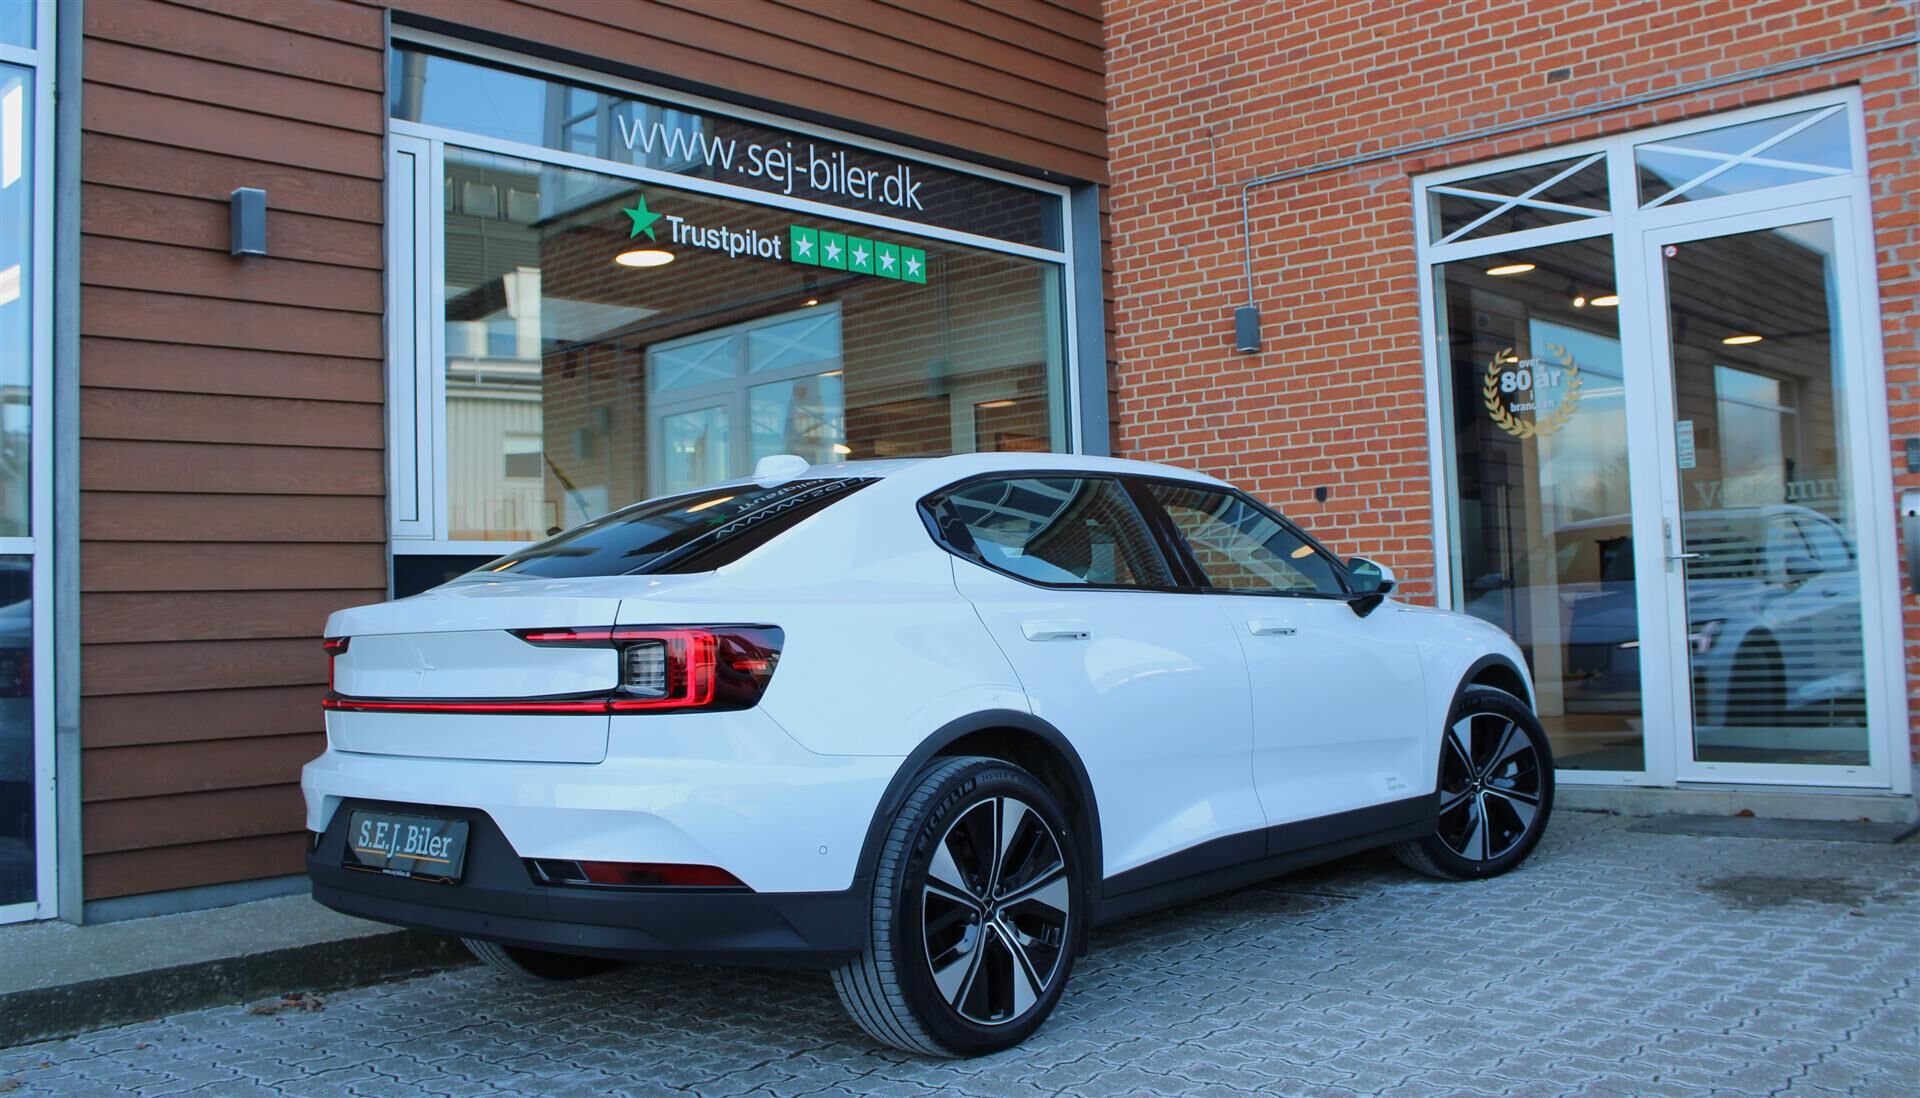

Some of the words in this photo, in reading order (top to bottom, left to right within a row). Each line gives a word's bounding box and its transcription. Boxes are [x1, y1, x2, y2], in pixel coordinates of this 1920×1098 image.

[618, 114, 923, 211] www.sej-biler.dk
[666, 215, 782, 260] Trustpilot
[1501, 369, 1532, 393] 80
[1519, 358, 1540, 369] over
[916, 779, 975, 854] MICHELIN
[358, 820, 400, 858] S.E.J.
[404, 825, 452, 857] Biler
